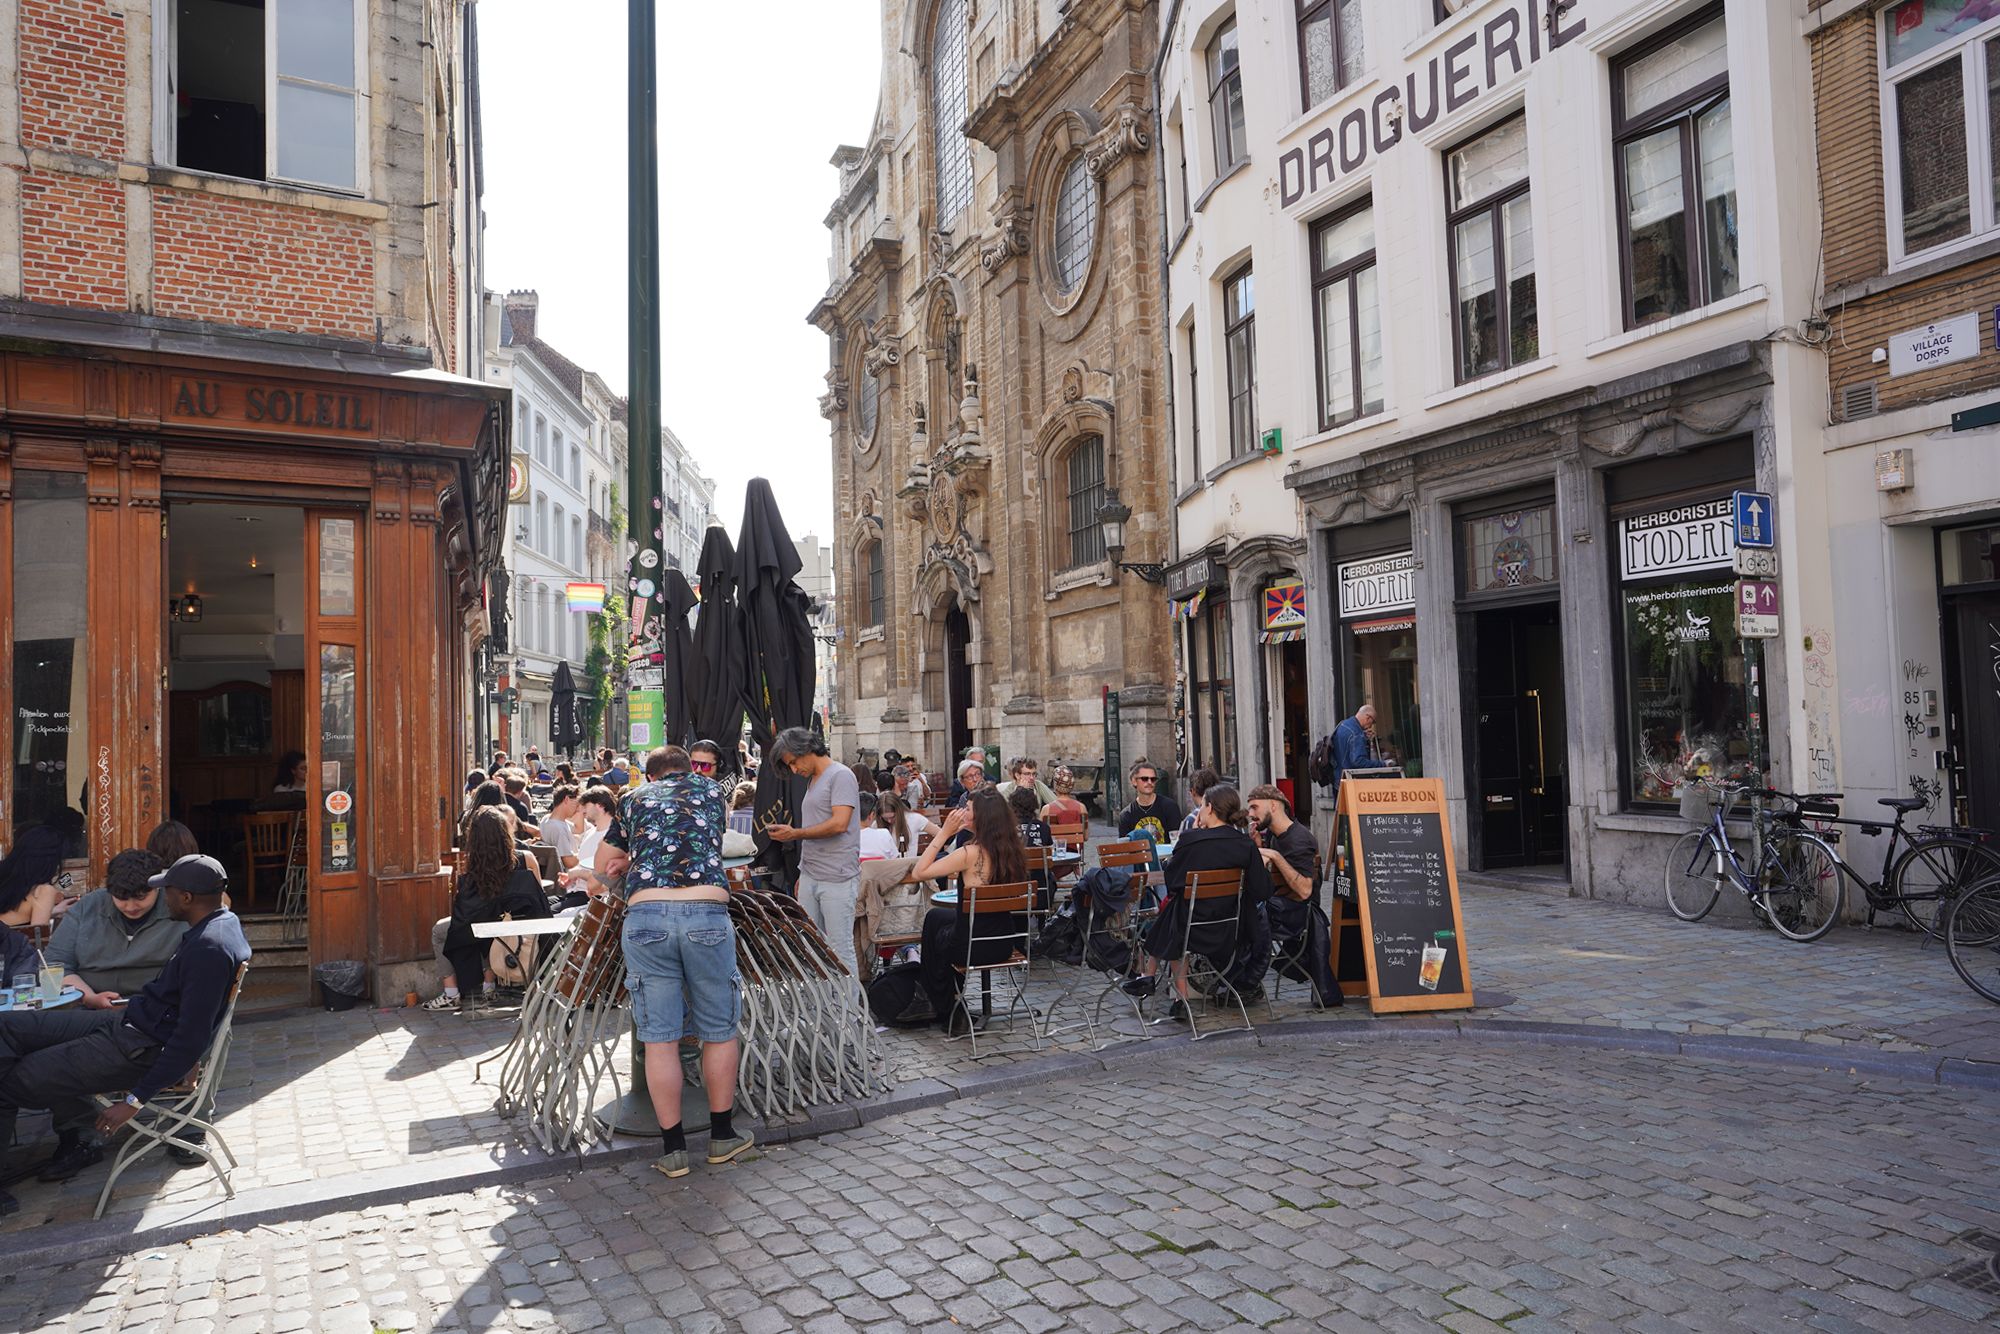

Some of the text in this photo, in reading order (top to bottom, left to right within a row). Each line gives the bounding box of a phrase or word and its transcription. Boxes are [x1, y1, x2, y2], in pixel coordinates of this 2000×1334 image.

[1279, 0, 1587, 210] DROGUERIE
[1912, 334, 1953, 352] VILLAGE
[1916, 346, 1950, 362] DORPS
[174, 380, 371, 433] AU SOLEIL
[1186, 559, 1210, 588] BROTHERS
[1353, 622, 1413, 635] www.damenature.be
[1680, 626, 1710, 640] Weyn's
[1904, 691, 1920, 704] 85
[1358, 790, 1437, 803] GEUZE BOON
